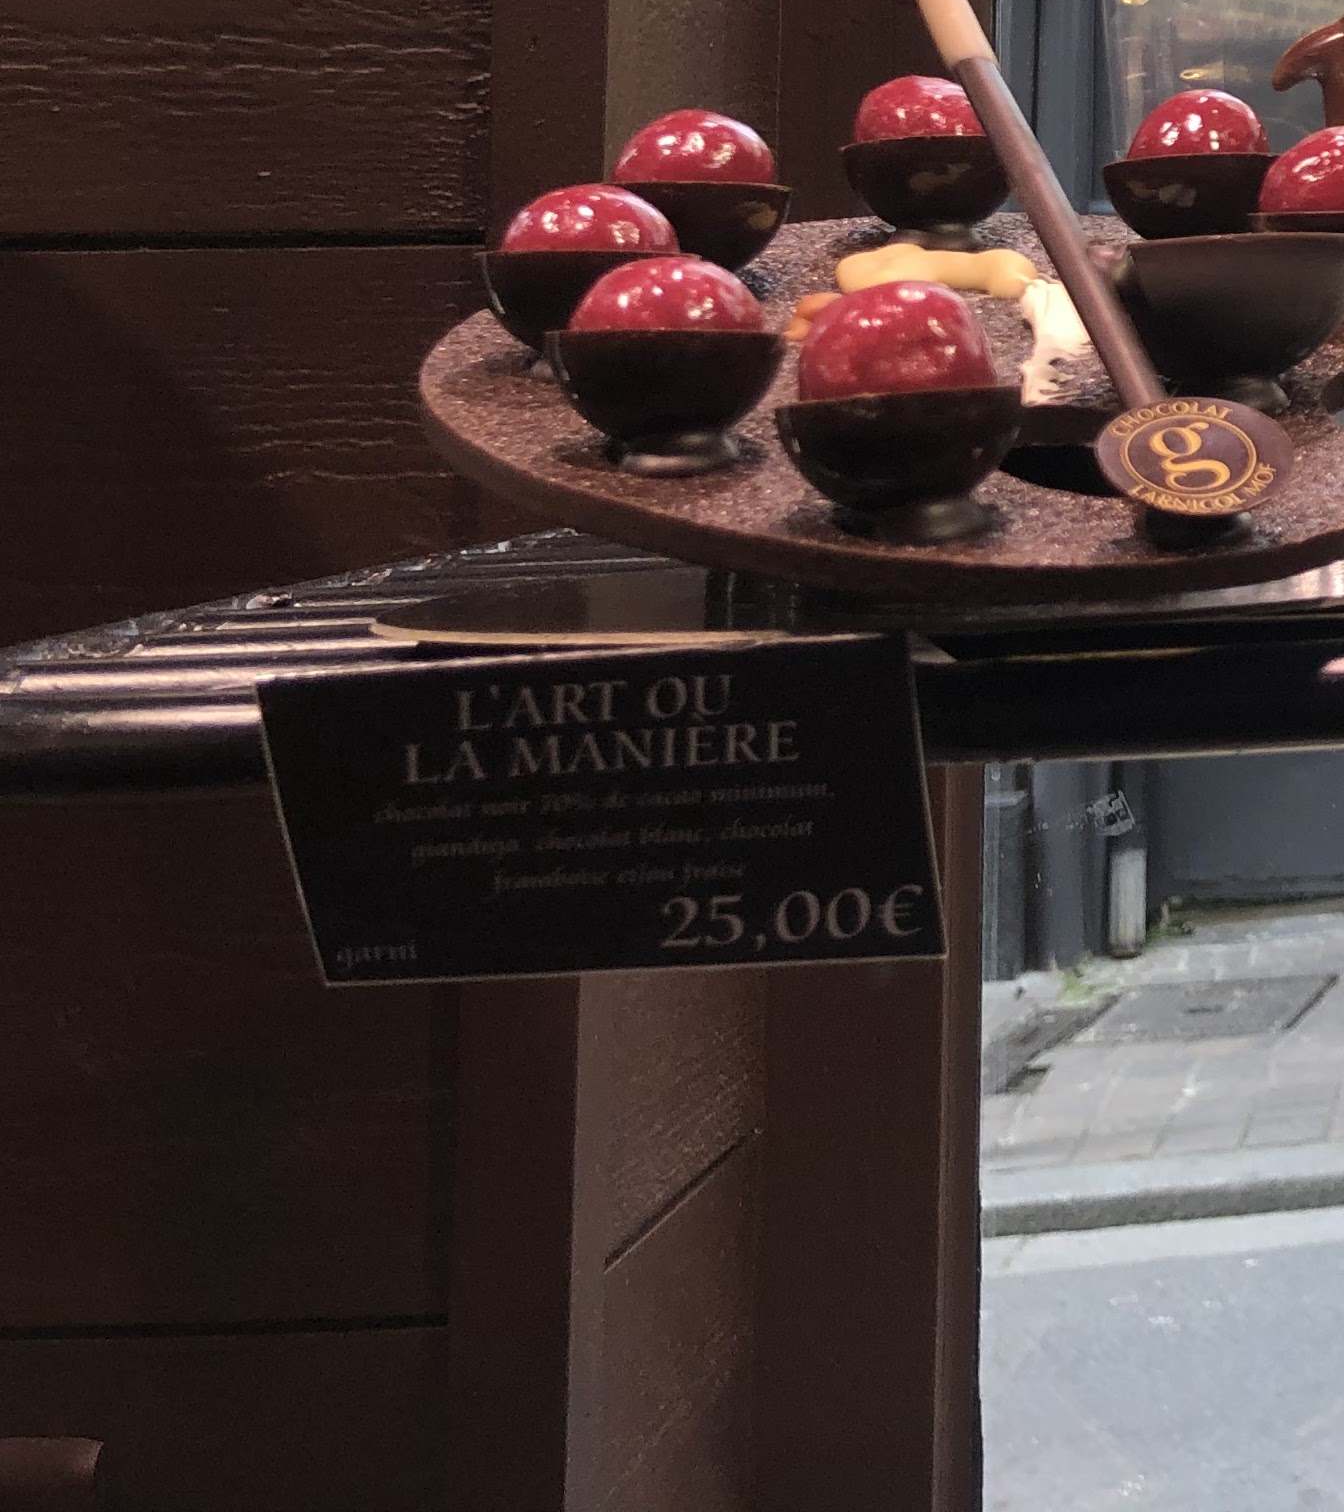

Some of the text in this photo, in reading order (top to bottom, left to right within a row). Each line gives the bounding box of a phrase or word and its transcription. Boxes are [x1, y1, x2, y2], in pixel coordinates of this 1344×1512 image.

[1109, 400, 1233, 437] CHOCOLAT
[1149, 421, 1231, 492] g
[1129, 461, 1277, 515] LARNICOL MOF
[454, 673, 735, 731] L'ART OU
[402, 739, 487, 785] LA
[658, 884, 924, 952] 25,00€
